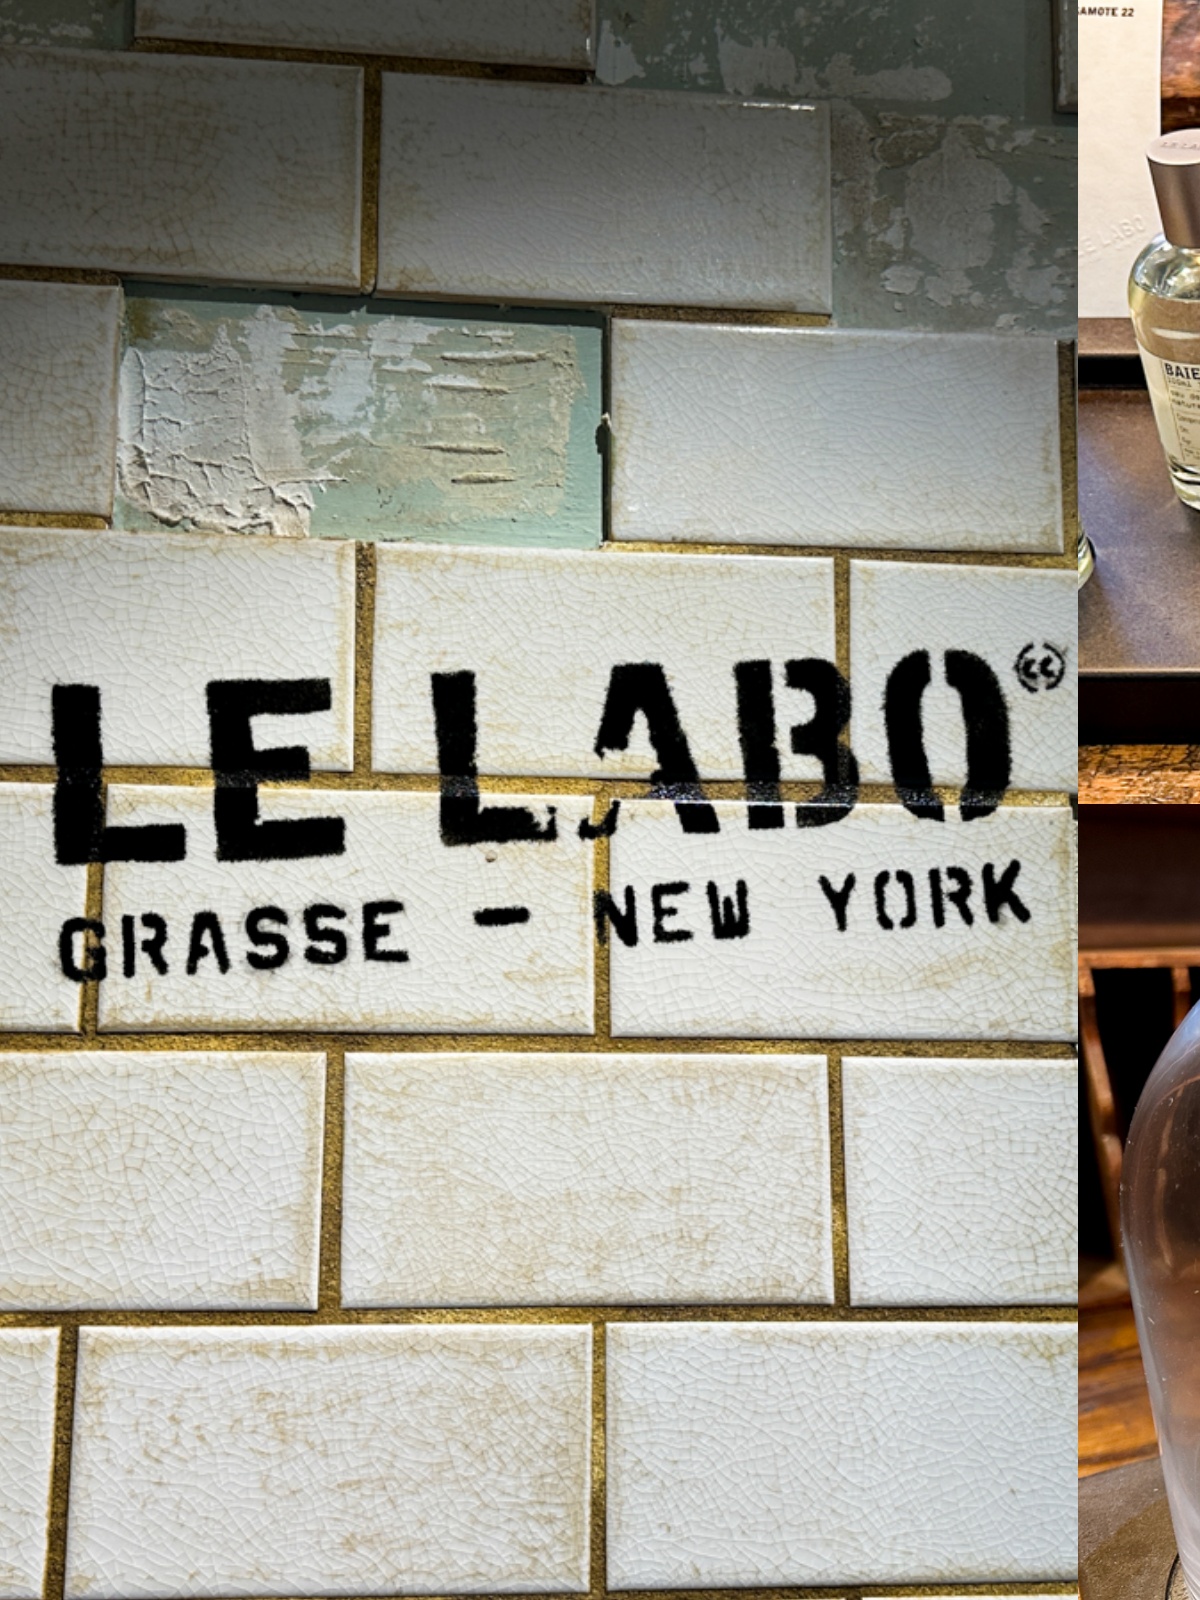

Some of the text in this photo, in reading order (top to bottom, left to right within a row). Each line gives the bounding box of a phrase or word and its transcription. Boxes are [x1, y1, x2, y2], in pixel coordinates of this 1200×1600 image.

[1078, 7, 1134, 17] AMOTE 22
[52, 648, 1012, 866] LE LABO
[58, 901, 410, 983] GRASSE
[593, 880, 750, 947] NEW
[819, 860, 1031, 931] YORK
